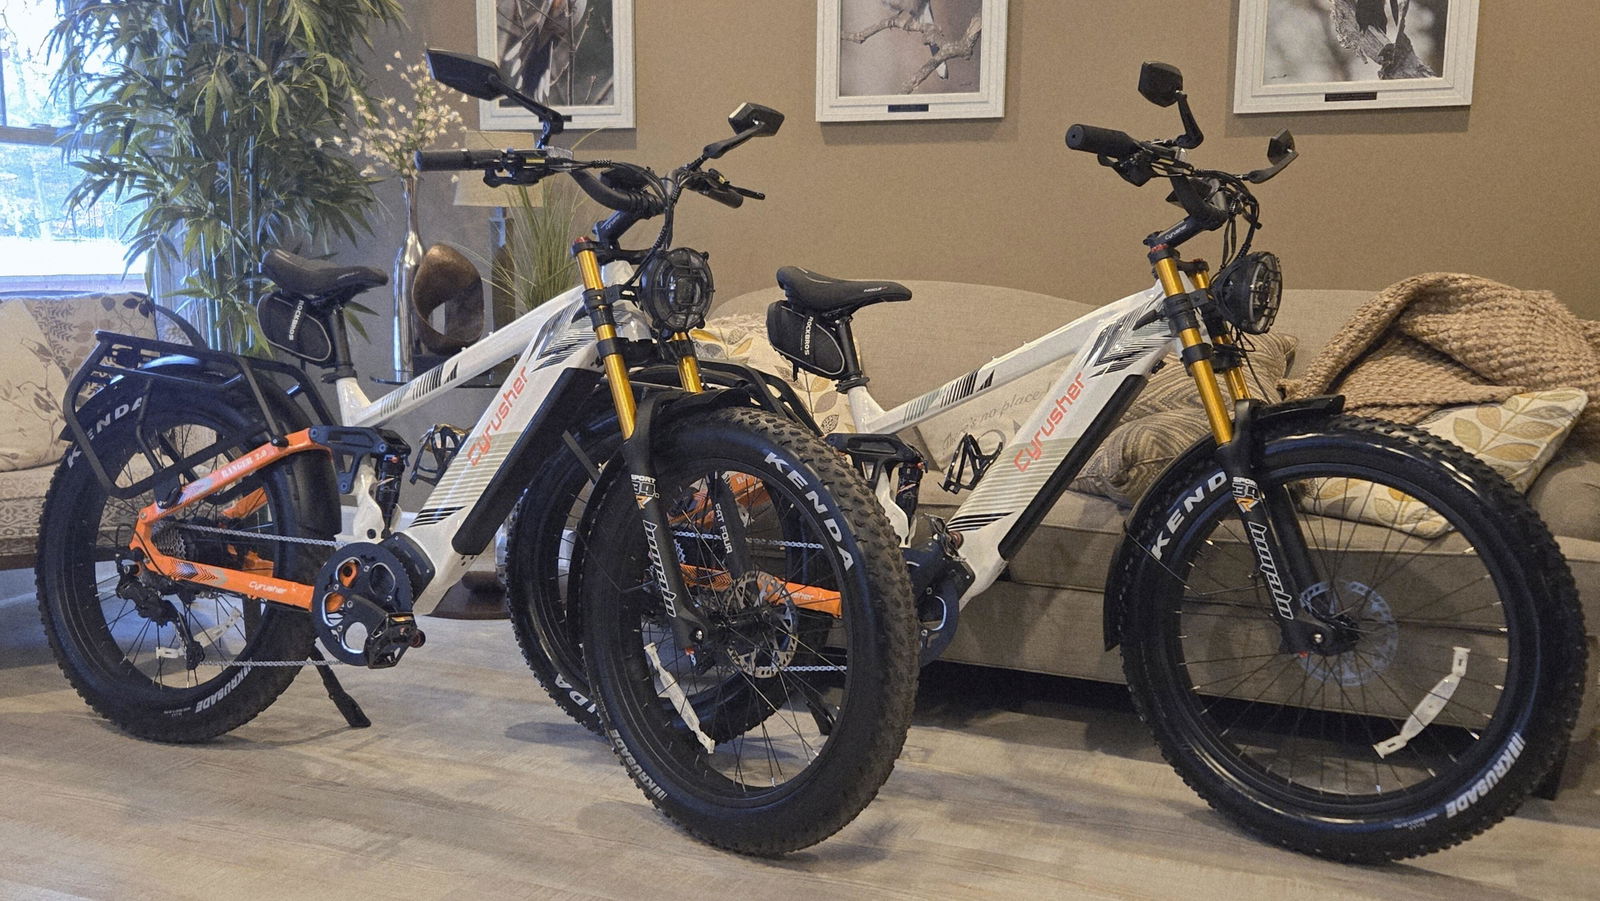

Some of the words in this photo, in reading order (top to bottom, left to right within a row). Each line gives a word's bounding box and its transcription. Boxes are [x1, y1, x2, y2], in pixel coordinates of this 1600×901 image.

[804, 316, 814, 356] ROCKBROS
[466, 366, 528, 467] Cyrusher
[999, 391, 1040, 418] place
[1013, 372, 1086, 473] Cyrusher
[719, 526, 733, 554] FOUR
[764, 451, 854, 572] KENDA
[1151, 470, 1228, 561] KEND
[248, 581, 288, 595] Cyrusher
[1445, 749, 1516, 819] KRUSADE
